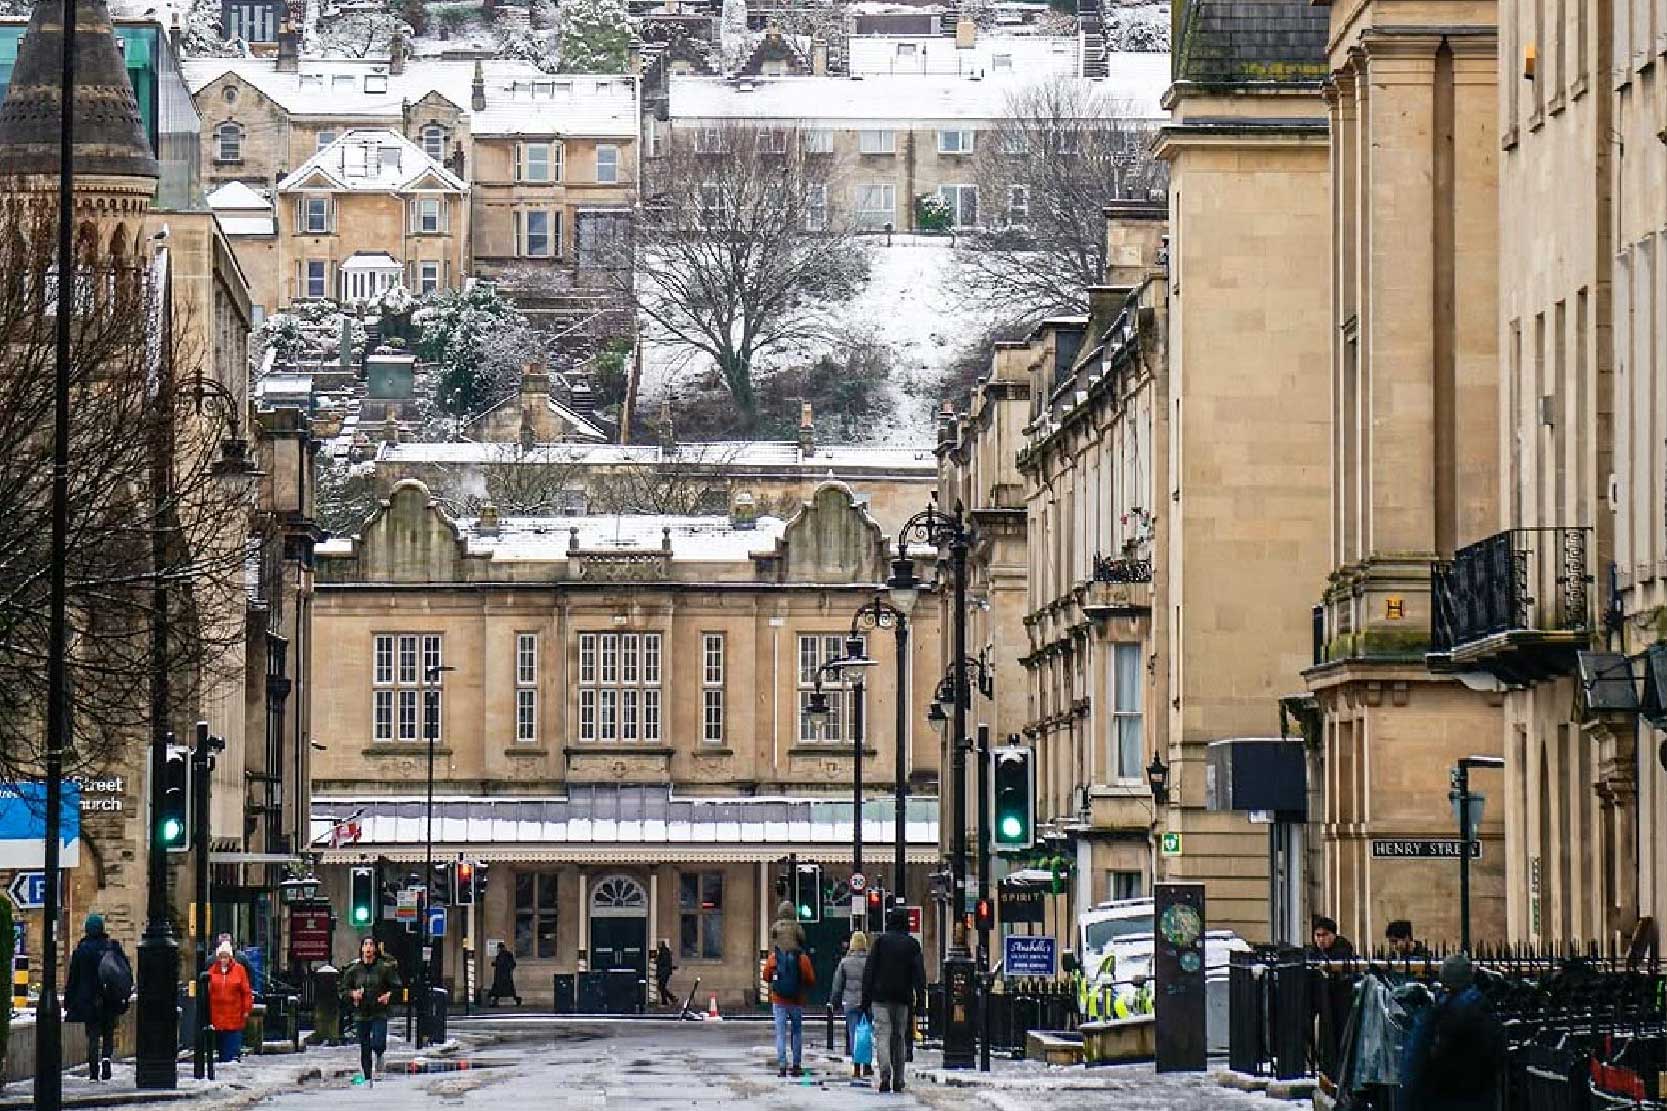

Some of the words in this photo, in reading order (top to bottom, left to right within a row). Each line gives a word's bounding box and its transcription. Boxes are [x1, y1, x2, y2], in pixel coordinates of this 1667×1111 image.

[79, 796, 123, 811] hurch
[1376, 842, 1422, 855] HENRY
[1429, 842, 1478, 855] STRET
